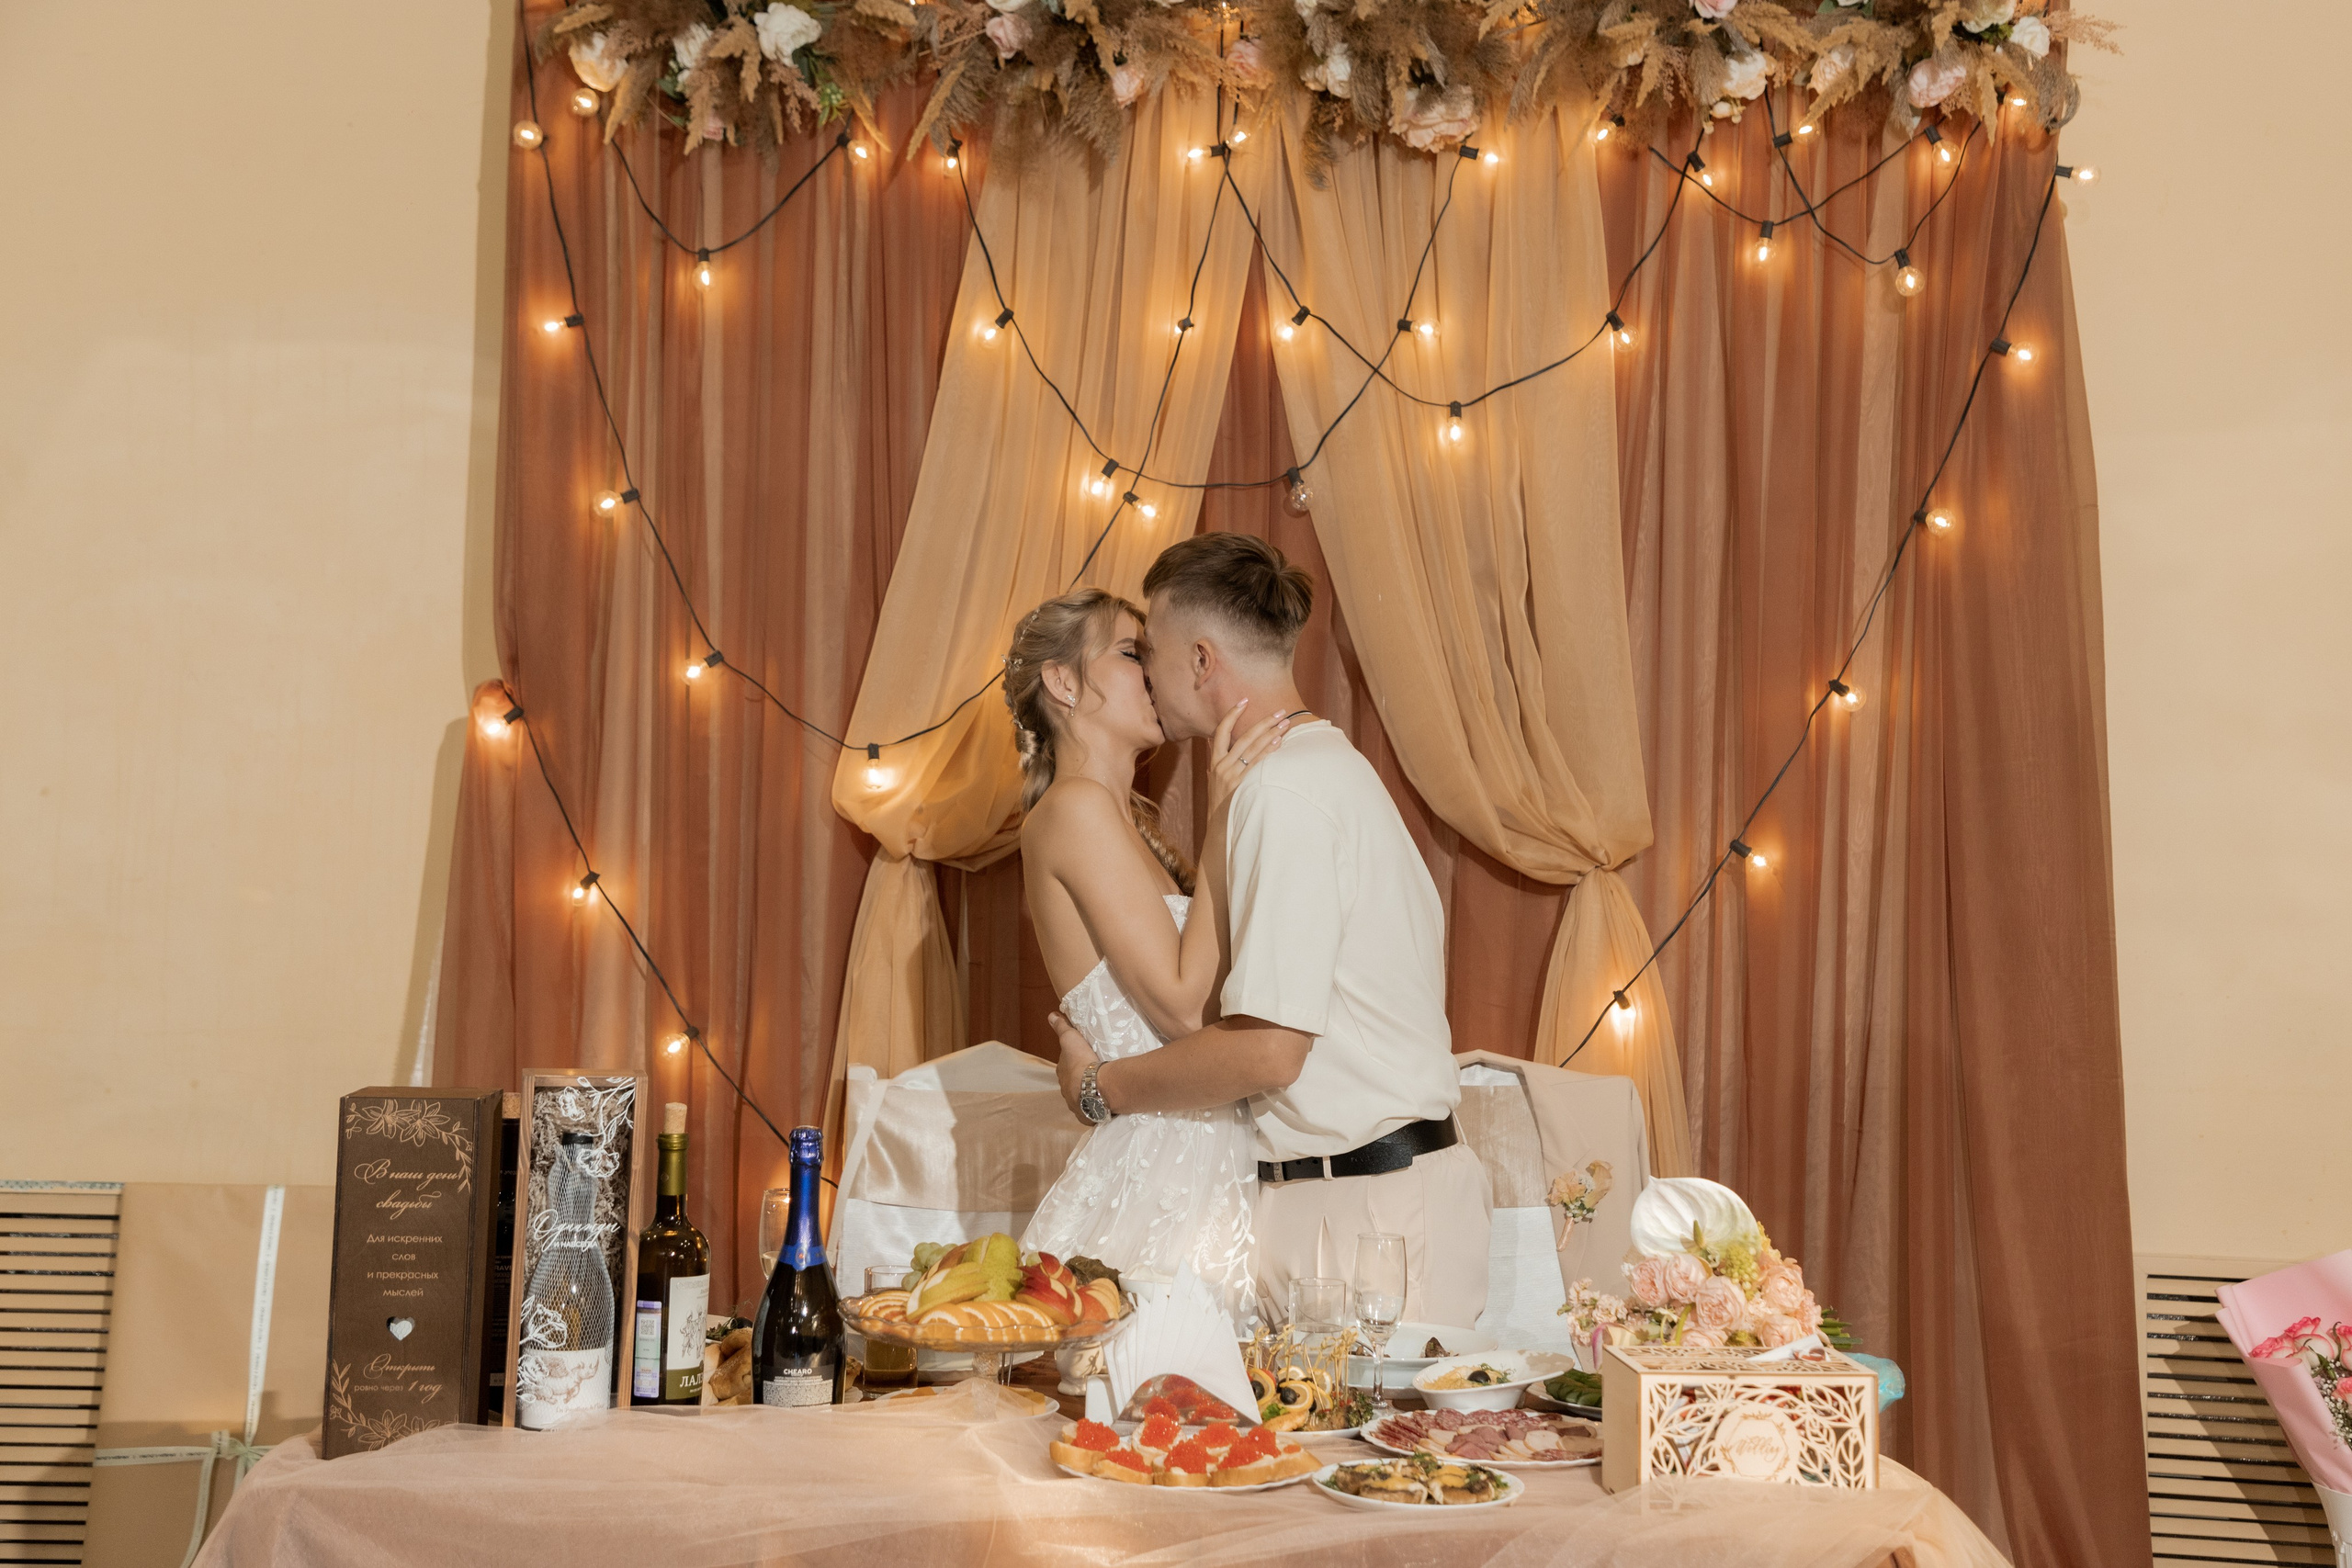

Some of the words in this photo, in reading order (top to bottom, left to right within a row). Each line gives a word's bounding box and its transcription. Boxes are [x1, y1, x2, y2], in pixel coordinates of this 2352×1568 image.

[354, 1158, 391, 1184] В
[389, 1171, 424, 1179] наш
[416, 1171, 458, 1191] день
[376, 1189, 442, 1220] свадьбы
[367, 1234, 385, 1244] Для
[387, 1235, 443, 1245] искренних
[391, 1253, 416, 1261] слов
[367, 1271, 374, 1280] и
[376, 1271, 438, 1280] прекрасных
[382, 1288, 424, 1297] мыслей
[363, 1353, 436, 1380] Открыть
[354, 1384, 379, 1393] ровно
[380, 1384, 404, 1393] через
[408, 1380, 419, 1392] 1
[418, 1383, 442, 1404] год
